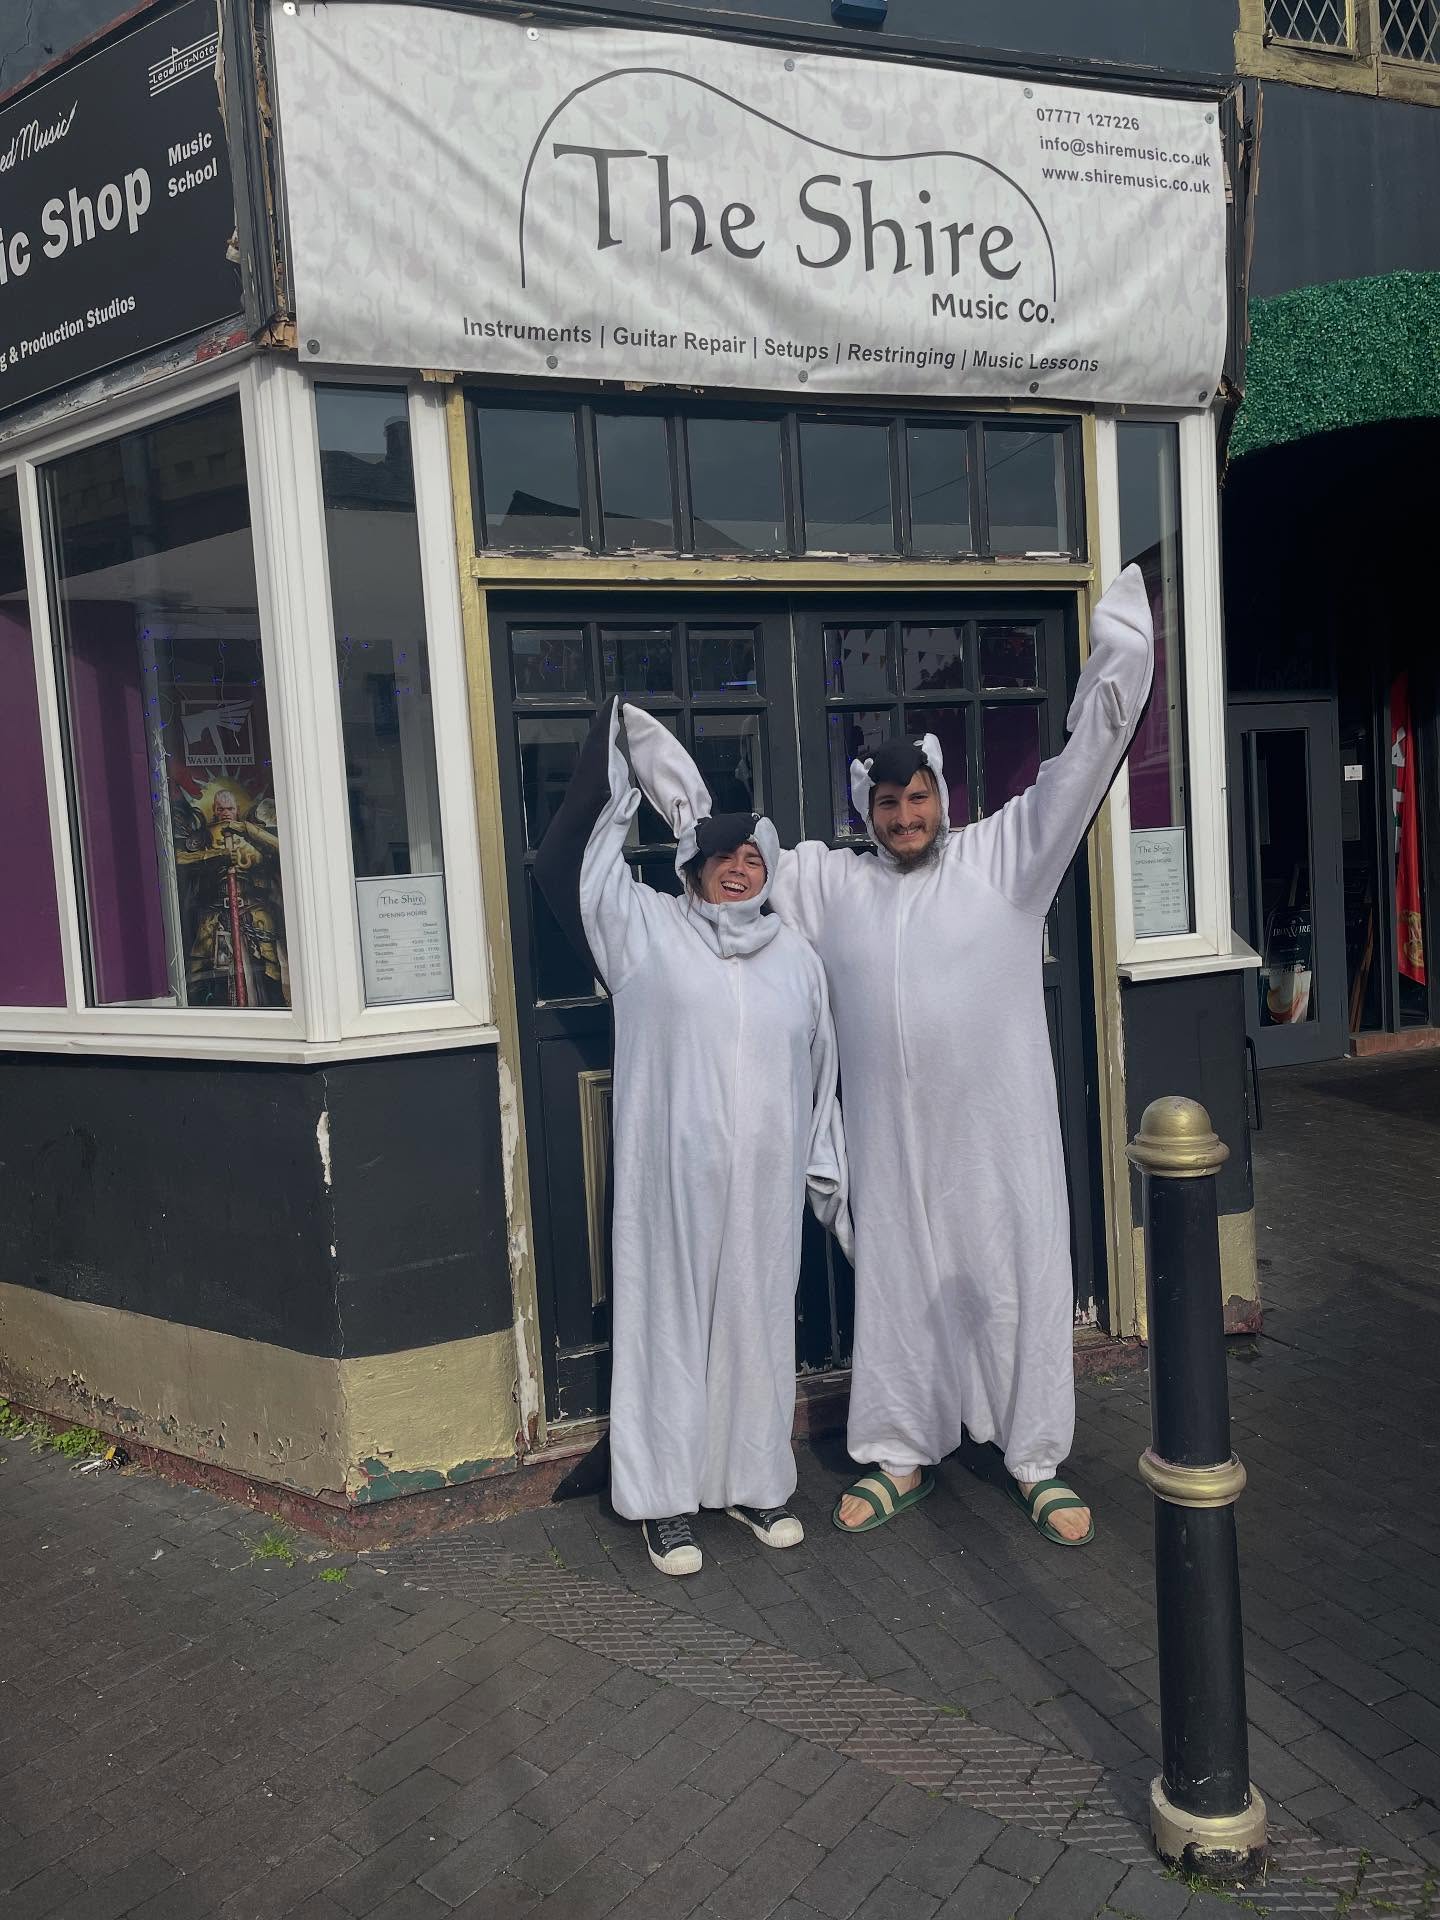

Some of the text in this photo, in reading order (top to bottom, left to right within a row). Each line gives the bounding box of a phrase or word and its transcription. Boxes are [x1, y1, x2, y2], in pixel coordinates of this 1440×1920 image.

[16, 100, 78, 161] Music
[1036, 108, 1140, 131] 07777 127226
[168, 132, 212, 167] Music
[1039, 136, 1211, 167] info@shiremusic.co.uk
[168, 157, 217, 198] School
[1041, 167, 1211, 194] www.shiremusic.co.uk
[41, 167, 151, 259] Shop
[553, 142, 1022, 281] The Shire
[932, 293, 1055, 324] Music Co.
[9, 346, 19, 364] &
[20, 318, 84, 359] Production
[86, 295, 136, 329] Studios
[463, 317, 592, 344] Instruments
[613, 326, 677, 349] Guitar
[684, 331, 747, 356] Repair
[764, 338, 829, 363] Setups
[847, 343, 956, 369] Restringing
[973, 350, 1023, 369] Music
[1030, 353, 1099, 373] Lessons
[187, 756, 253, 765] WARHAMMER
[380, 896, 399, 905] The
